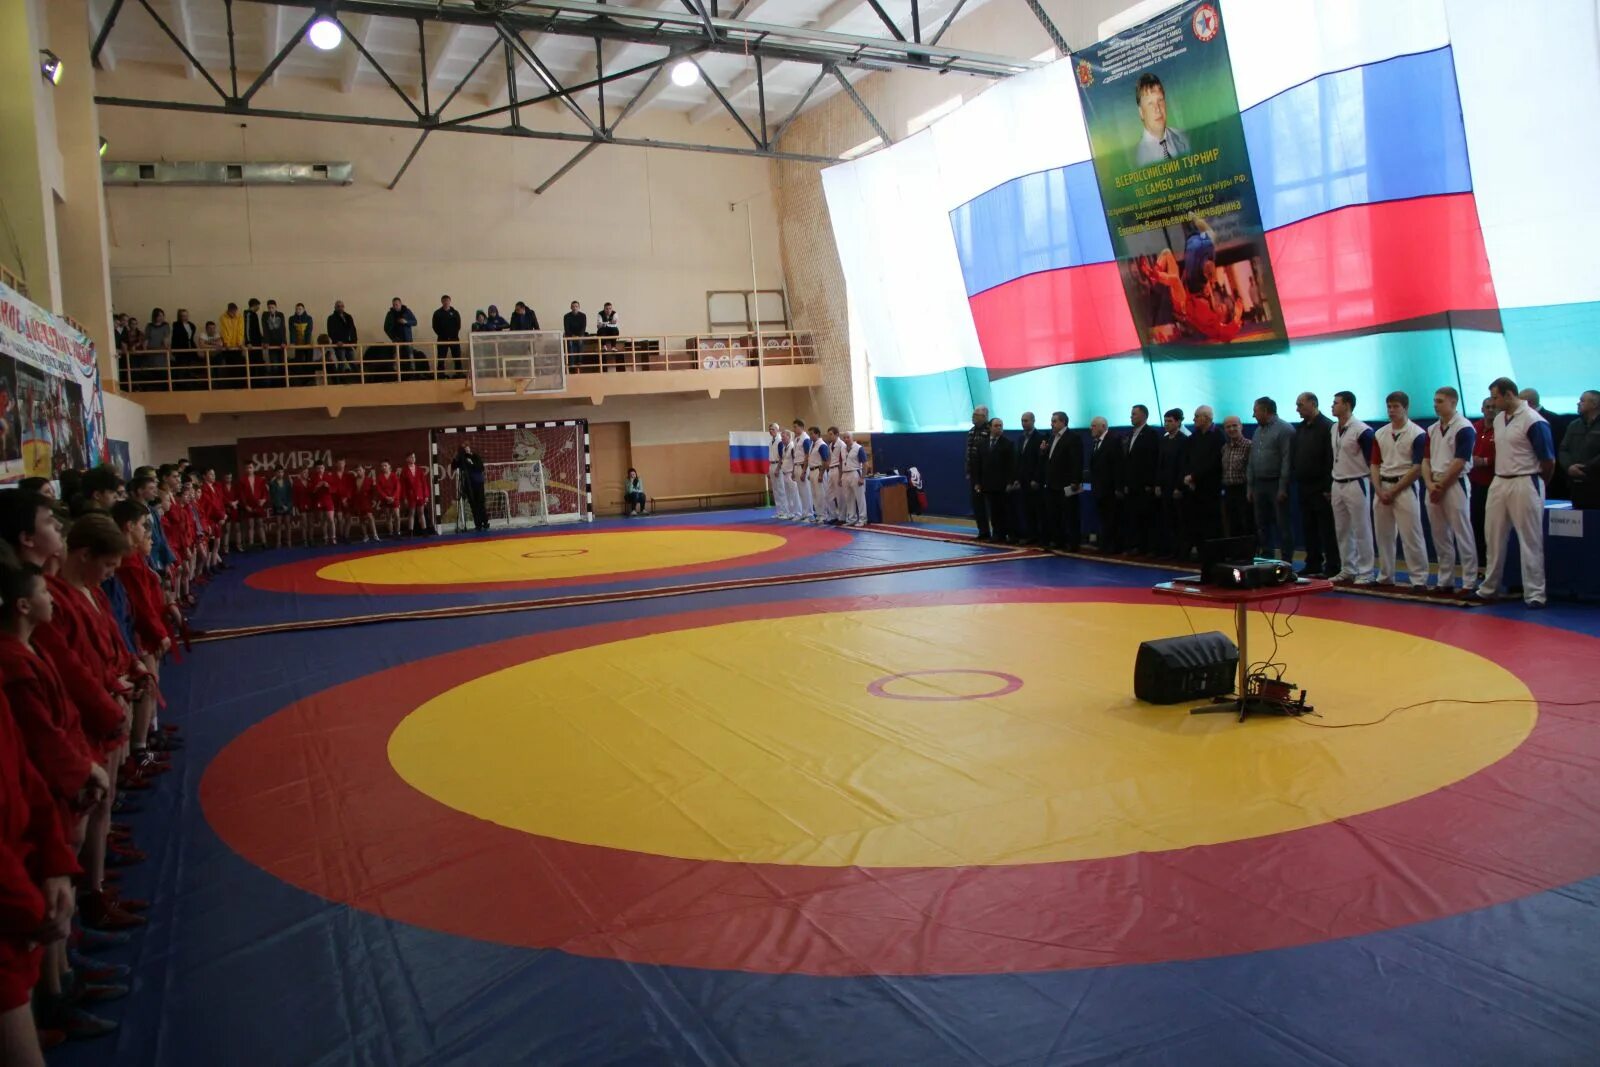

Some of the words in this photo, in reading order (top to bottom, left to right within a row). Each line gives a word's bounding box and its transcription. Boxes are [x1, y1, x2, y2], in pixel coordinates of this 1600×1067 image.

[1183, 148, 1219, 168] ТУРНИР
[1136, 188, 1144, 198] по
[1146, 178, 1173, 194] САМБО
[1176, 173, 1202, 187] памяти
[1198, 193, 1214, 205] СССР
[252, 450, 333, 472] ЖИВИ
